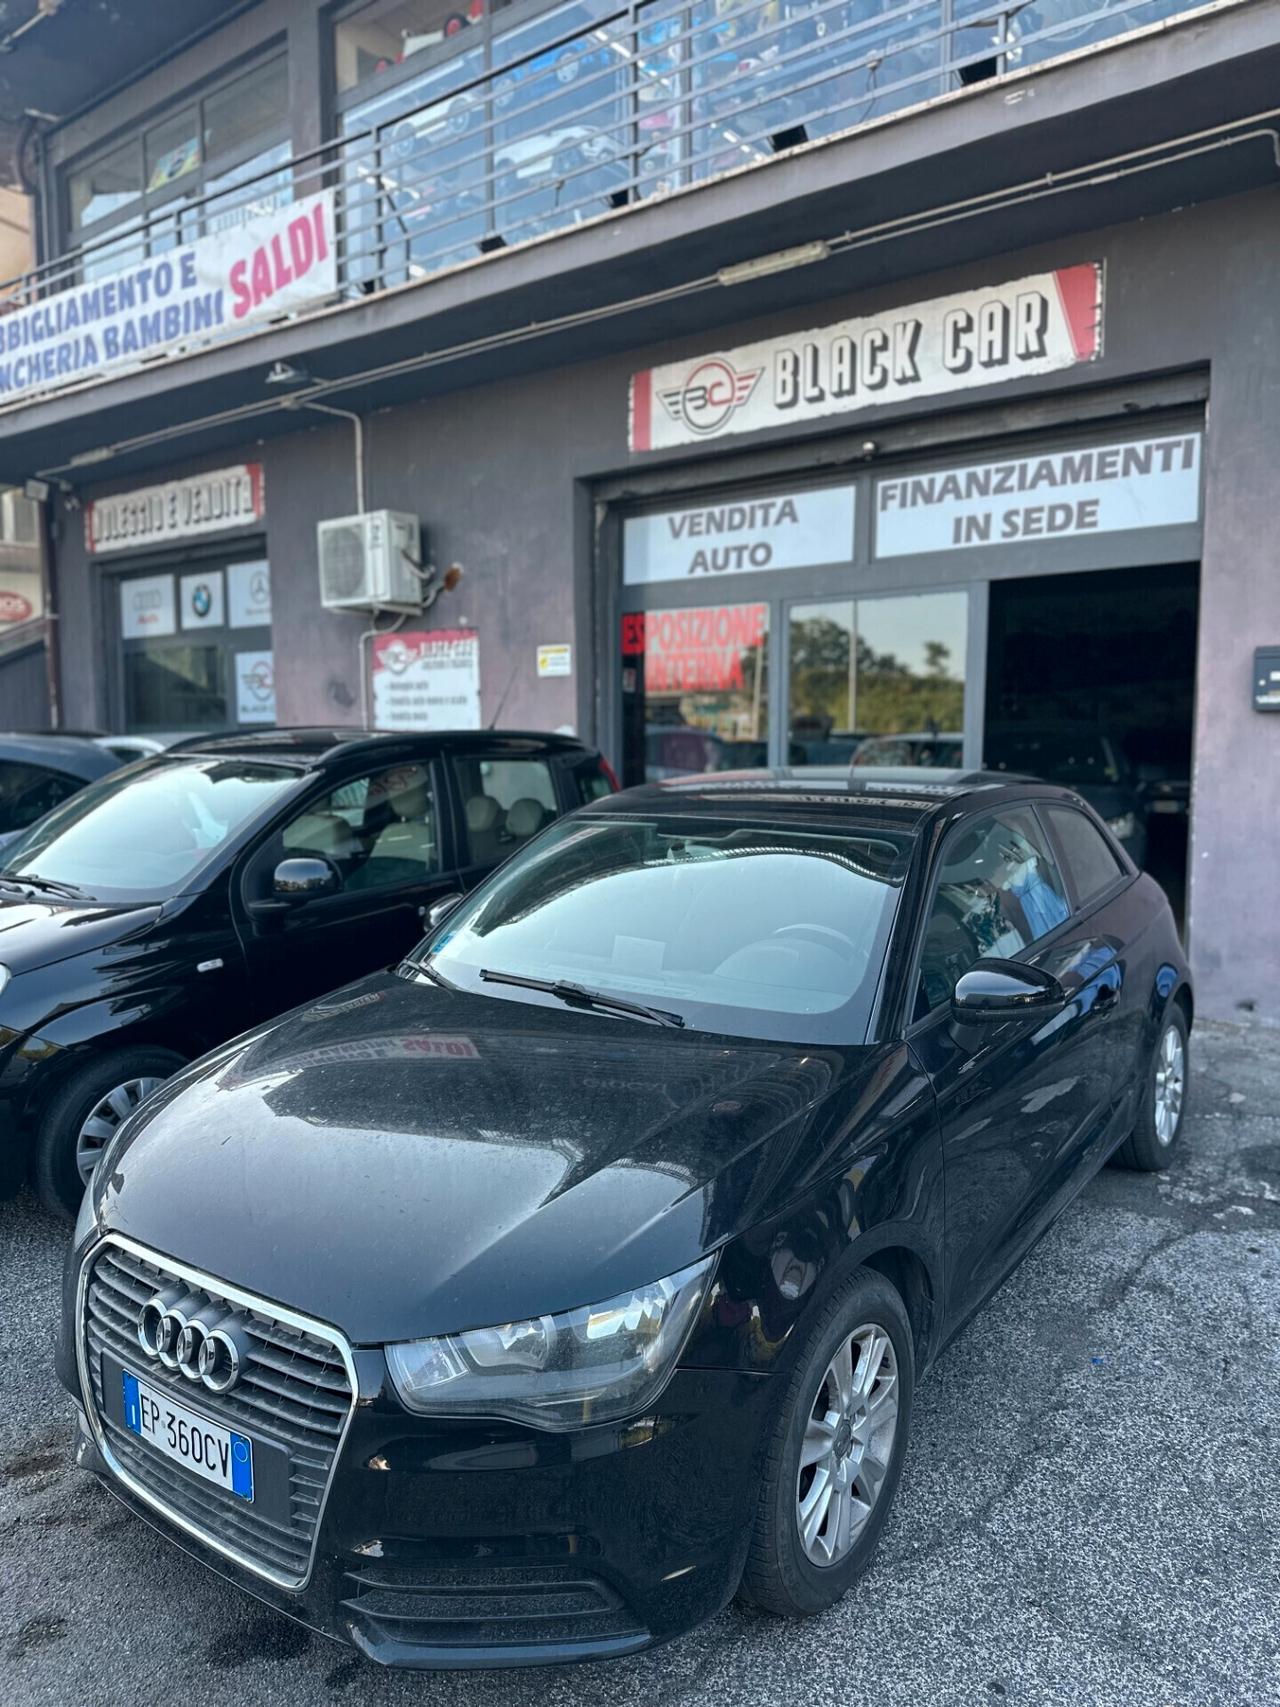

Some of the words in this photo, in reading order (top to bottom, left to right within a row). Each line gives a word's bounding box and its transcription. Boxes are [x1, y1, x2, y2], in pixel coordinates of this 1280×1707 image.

[180, 251, 197, 288] E
[229, 203, 328, 319] SALDI
[102, 289, 225, 359] BAMBINI
[774, 318, 922, 410] BLACK
[942, 290, 1049, 375] CAR
[880, 437, 1195, 512] FINANZIAMENTI
[667, 498, 799, 539] VENDITA
[952, 513, 992, 544] IN
[1001, 499, 1099, 539] SEDE
[688, 541, 772, 574] AUTO
[621, 605, 764, 654] ESPOSIZIONE
[645, 650, 744, 691] INTERNA
